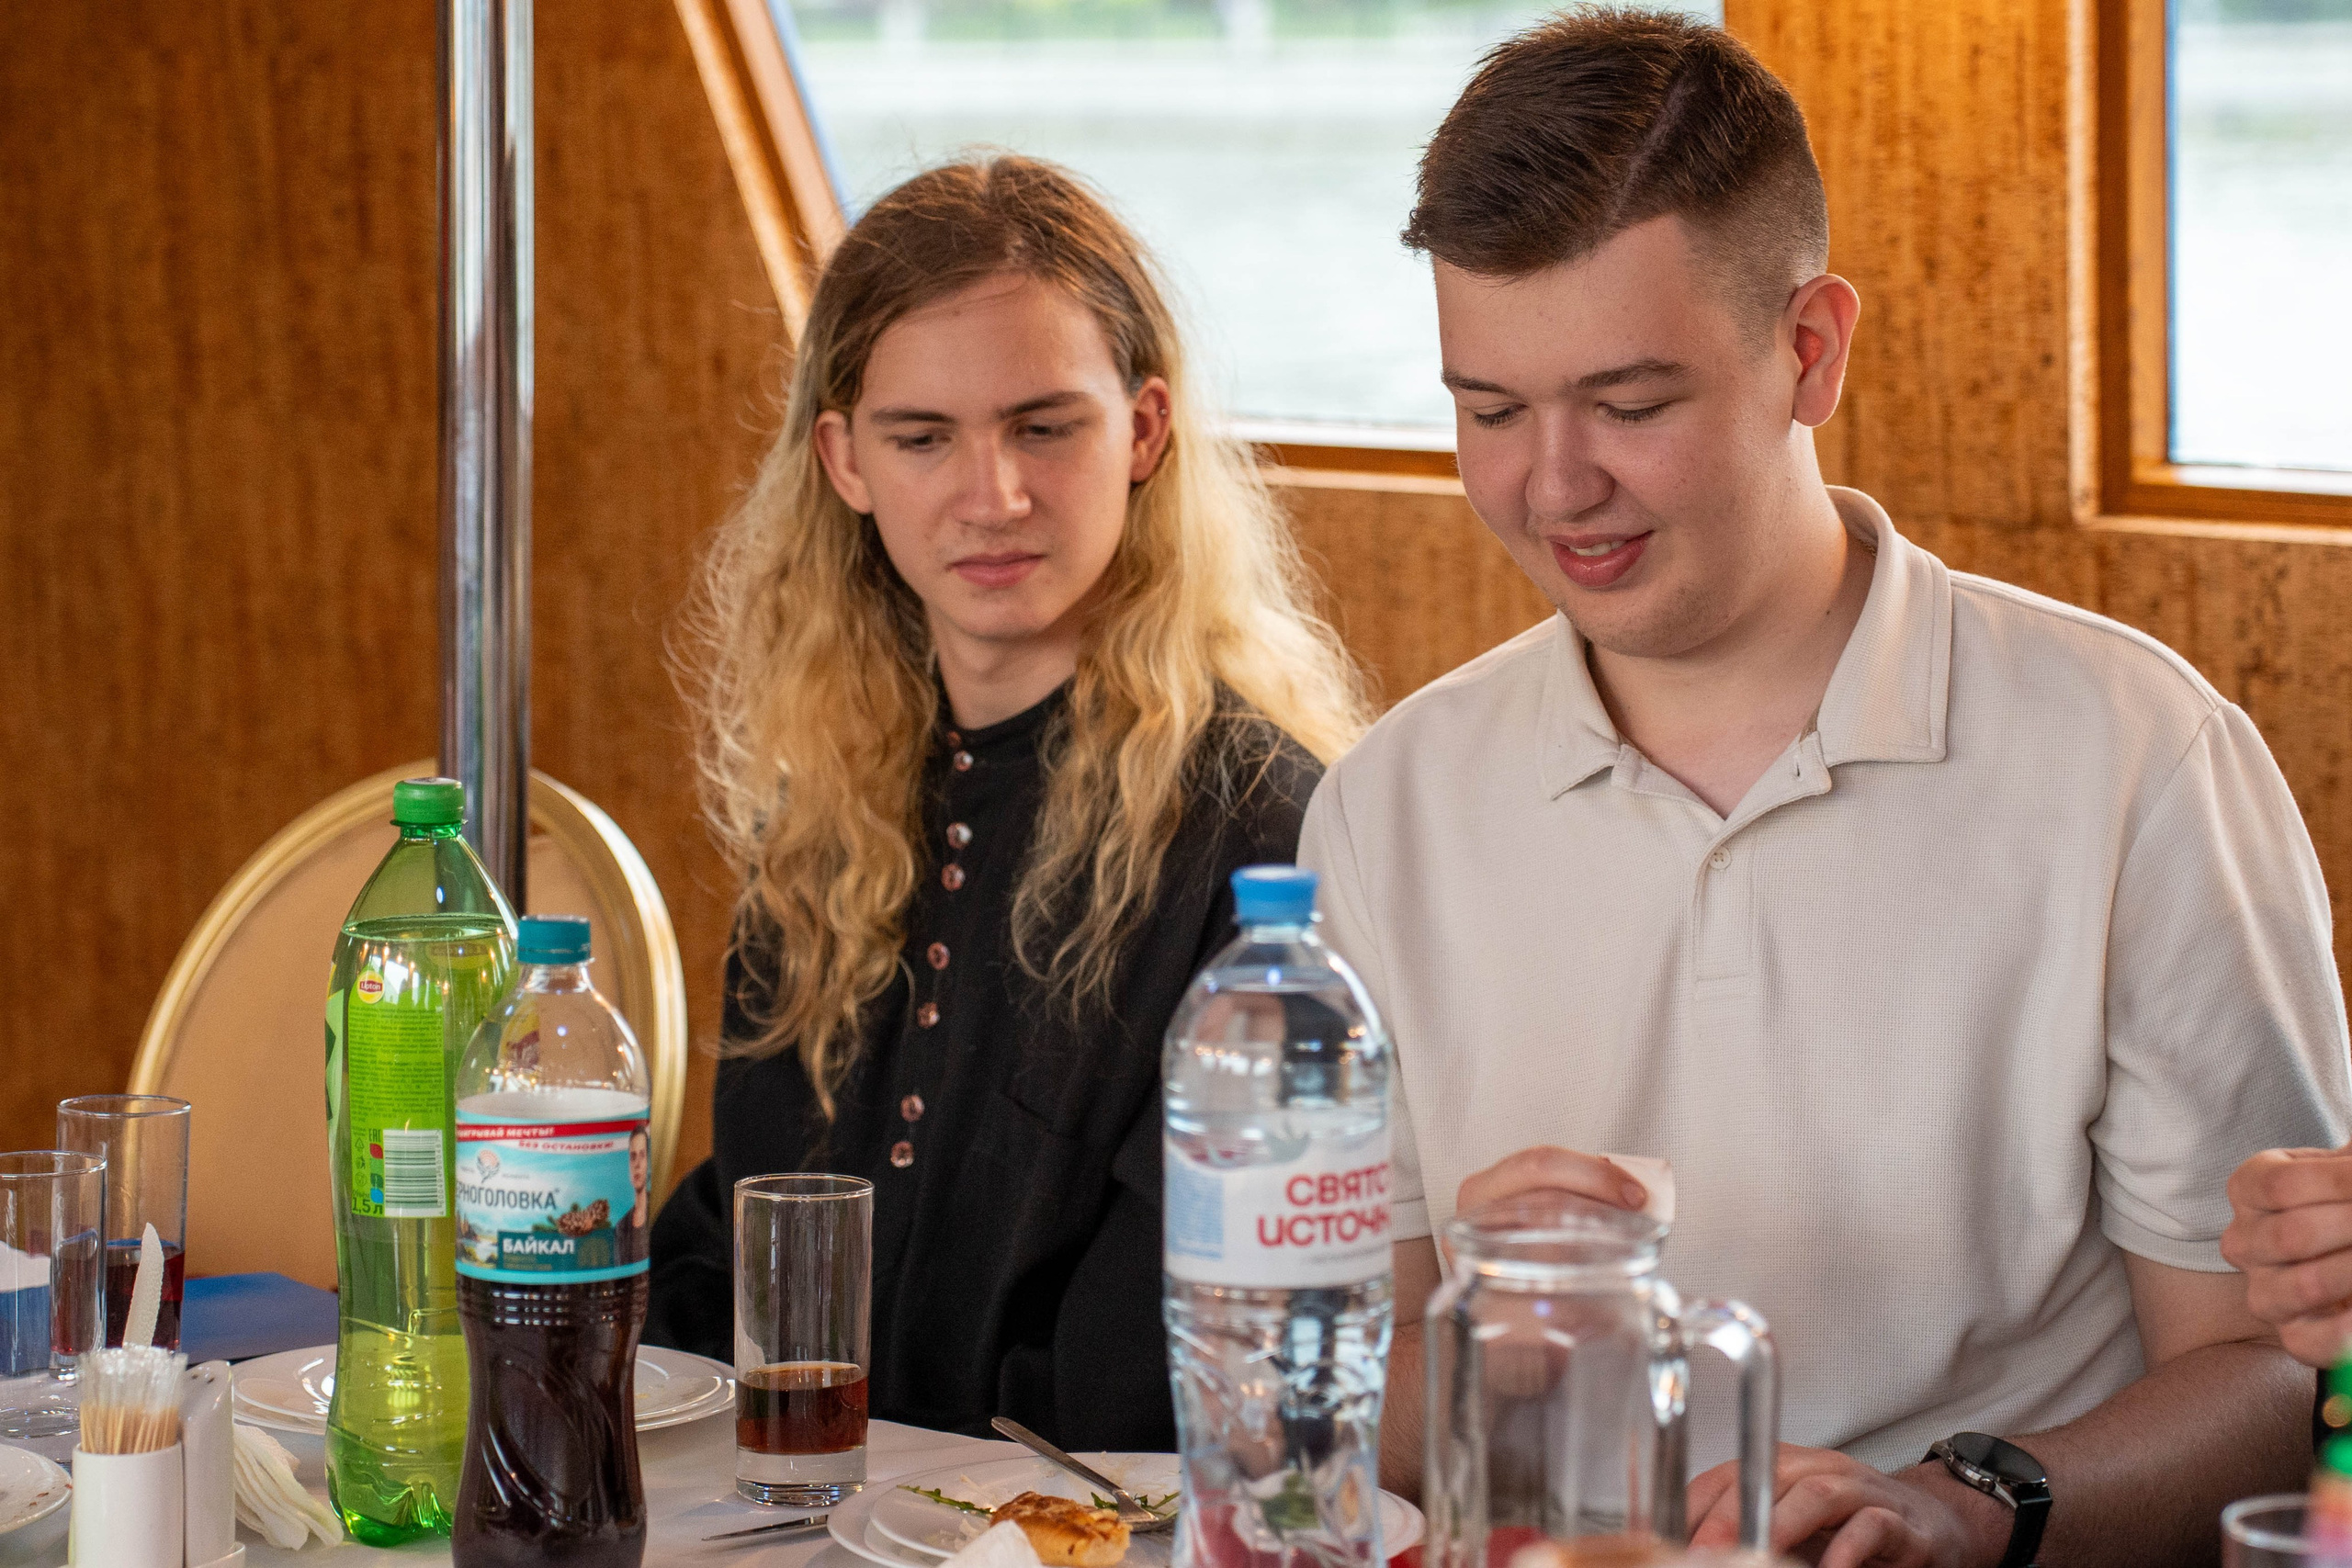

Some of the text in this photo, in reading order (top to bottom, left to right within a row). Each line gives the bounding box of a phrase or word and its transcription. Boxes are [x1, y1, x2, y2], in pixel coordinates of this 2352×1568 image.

[361, 981, 381, 991] Lipton
[352, 1197, 383, 1214] 1,5 л
[503, 1235, 574, 1255] БАЙКАЛ
